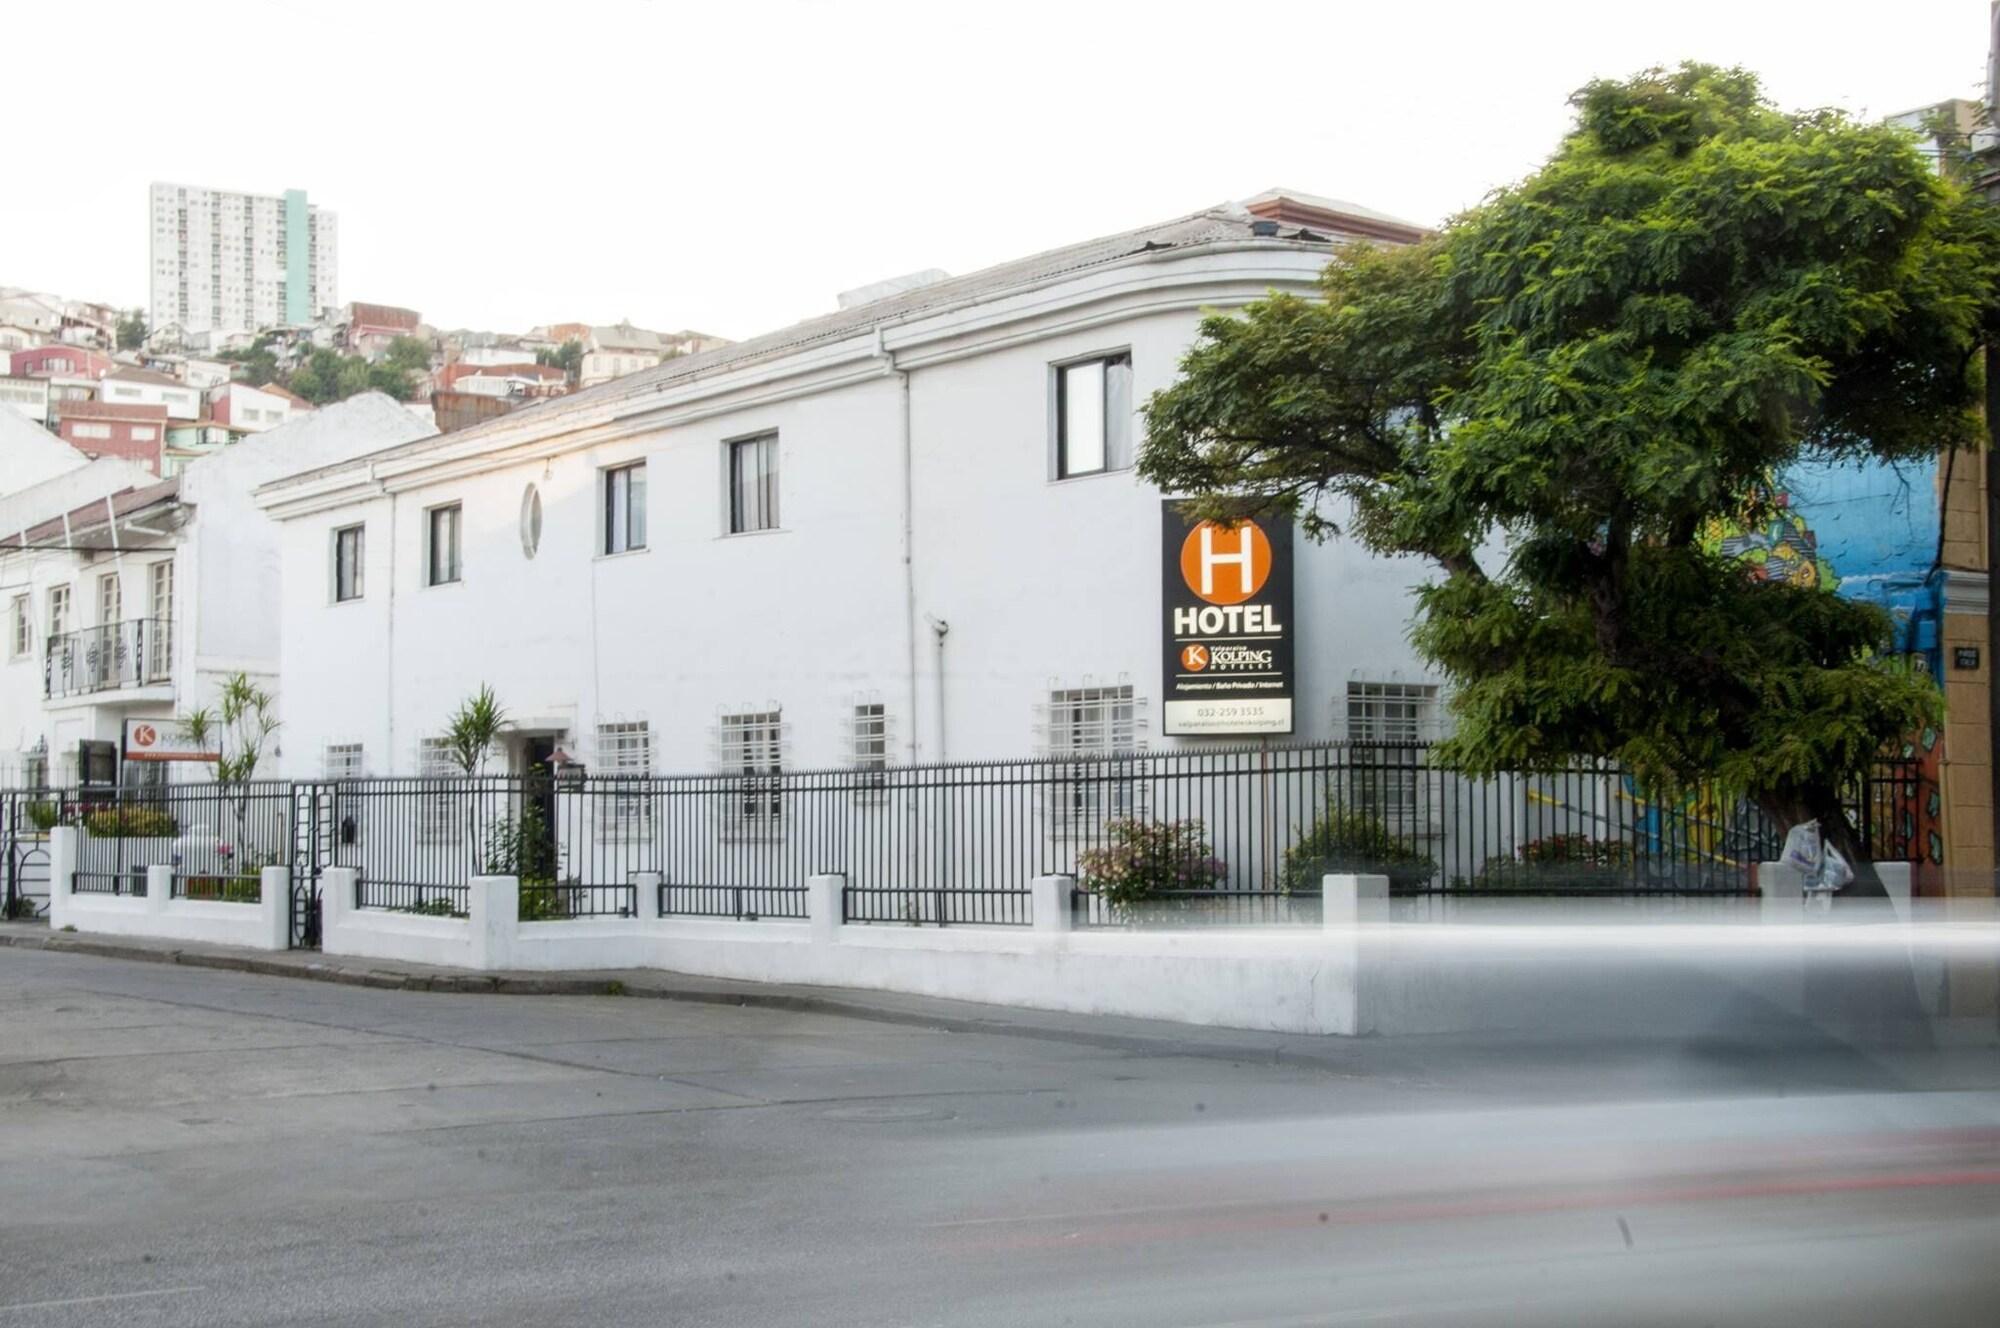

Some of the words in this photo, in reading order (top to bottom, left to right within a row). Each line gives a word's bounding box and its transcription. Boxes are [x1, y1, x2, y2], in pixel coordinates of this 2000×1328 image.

[1201, 526, 1253, 595] H
[1174, 604, 1282, 635] HOTEL
[1186, 646, 1206, 666] K
[1210, 650, 1272, 665] KOLPING
